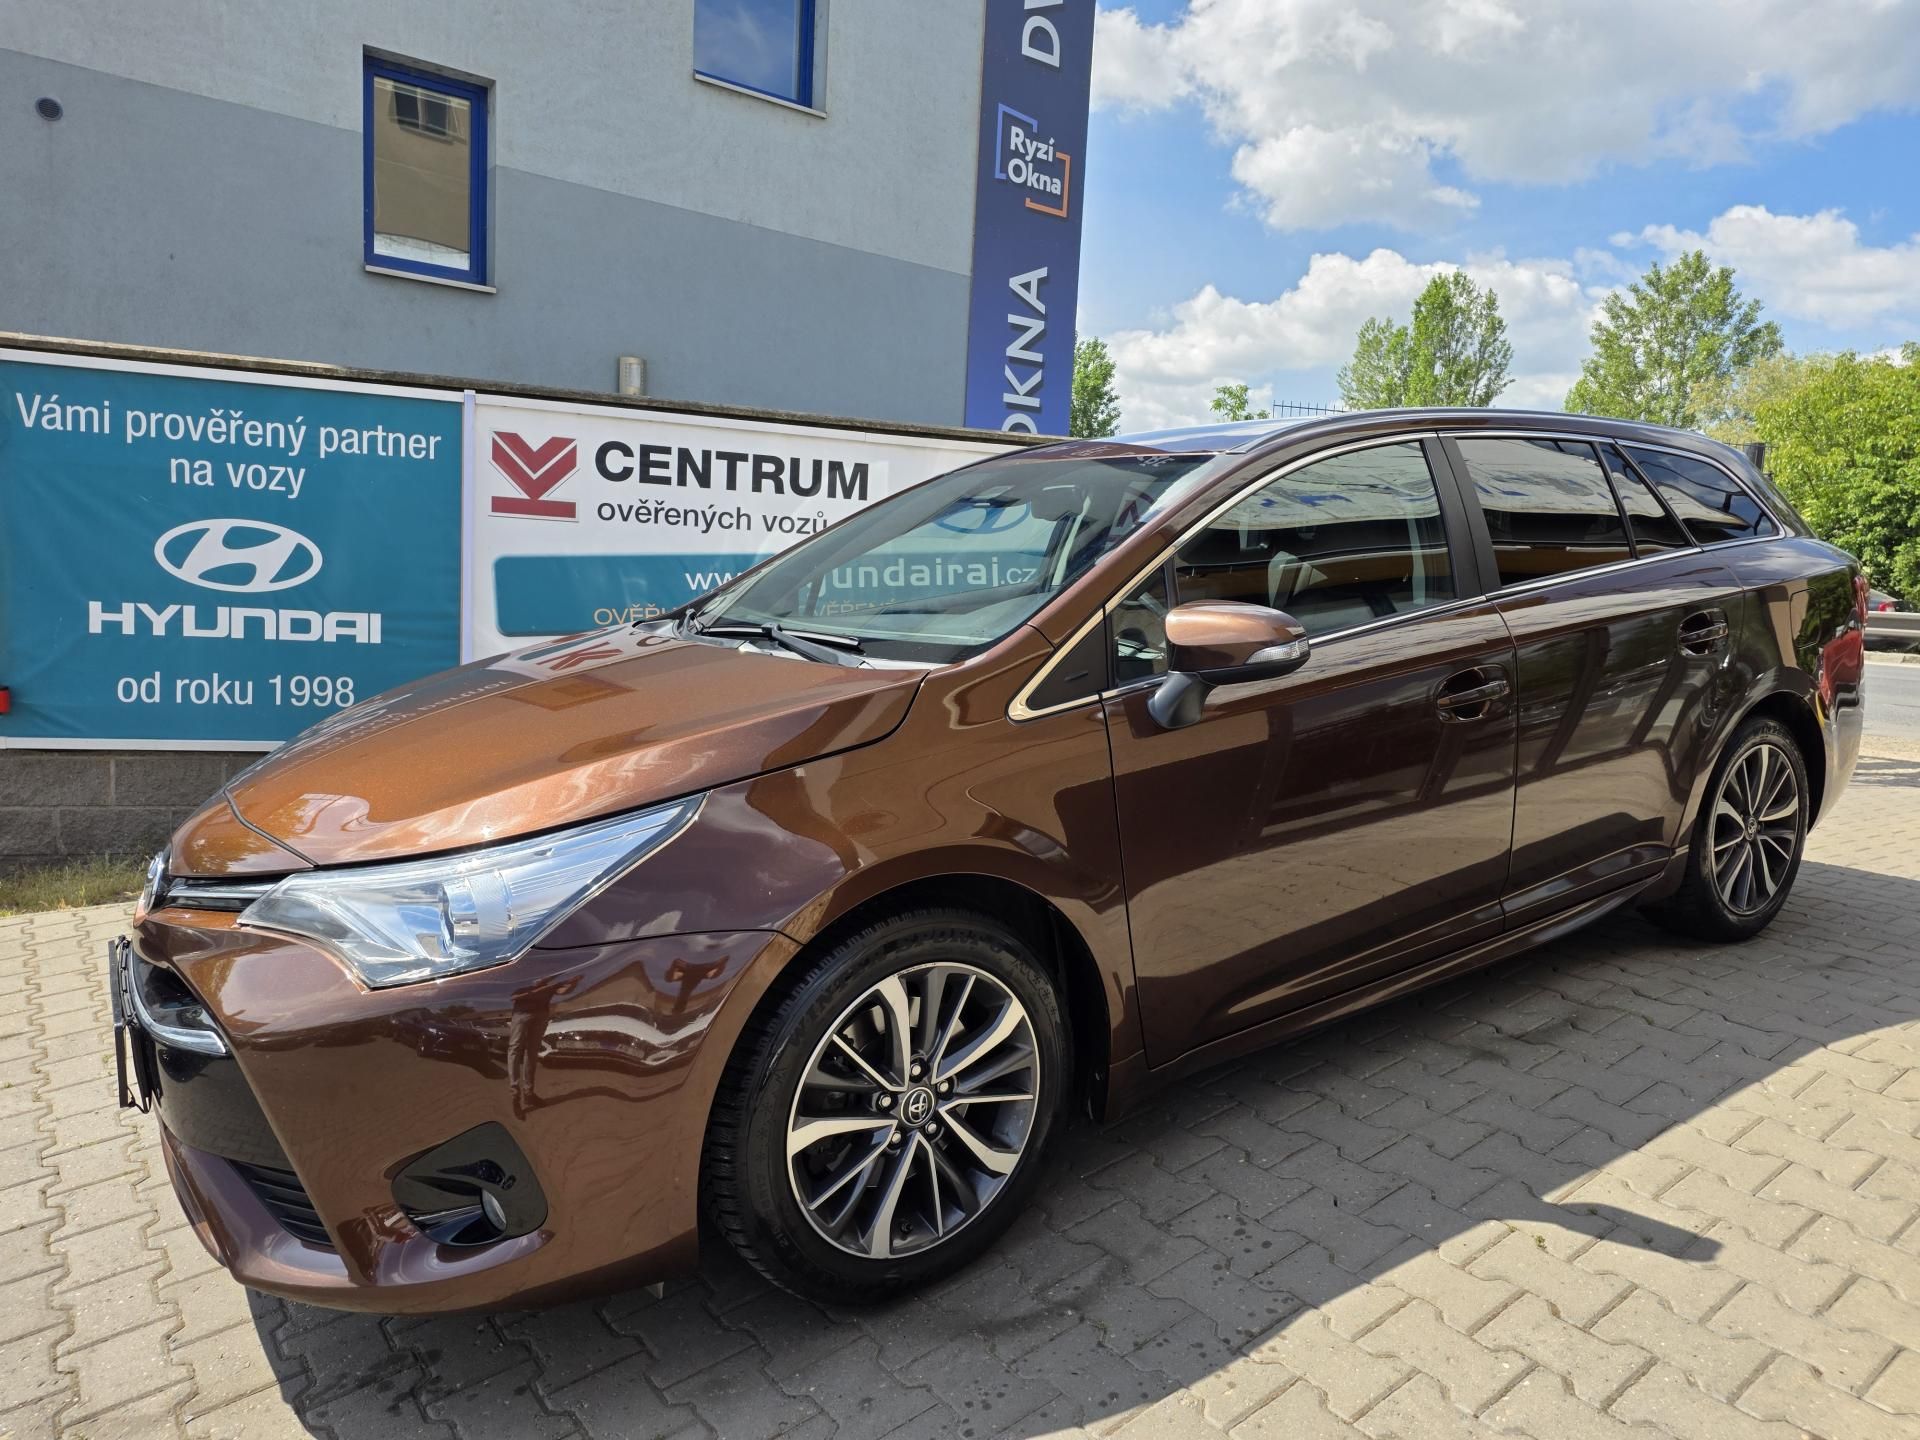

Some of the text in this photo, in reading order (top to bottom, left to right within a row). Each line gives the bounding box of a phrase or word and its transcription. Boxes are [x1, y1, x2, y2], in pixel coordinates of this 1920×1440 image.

[1021, 0, 1064, 69] D
[1007, 158, 1062, 195] Okna
[15, 392, 442, 460] Vámi prověřený partner
[169, 456, 306, 499] na vozy
[594, 440, 869, 501] CENTRUM
[596, 497, 828, 534] ověřených vozů
[684, 571, 743, 591] ww
[88, 600, 382, 645] HYUNDAI
[116, 670, 356, 708] od roku 1998
